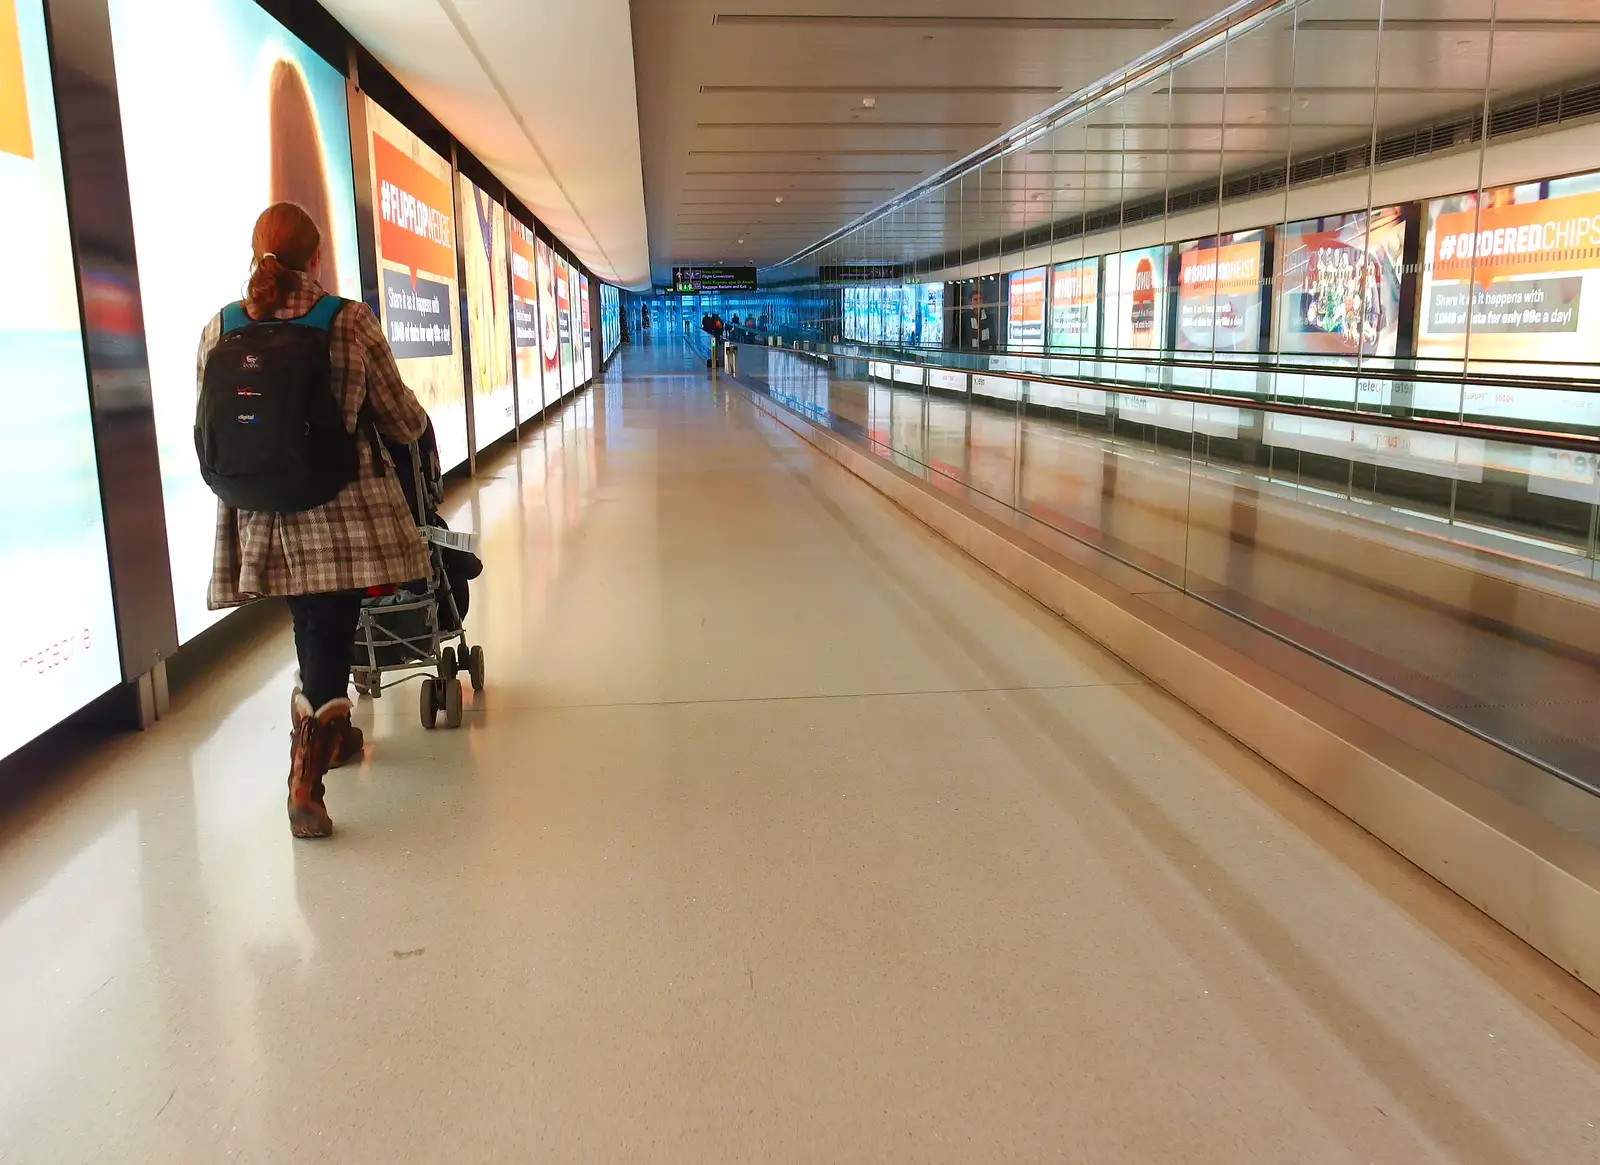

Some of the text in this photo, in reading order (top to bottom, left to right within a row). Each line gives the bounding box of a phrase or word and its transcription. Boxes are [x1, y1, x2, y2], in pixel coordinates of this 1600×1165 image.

[1435, 294, 1458, 307] Share
[1458, 292, 1466, 306] it
[1478, 292, 1484, 304] it
[1485, 291, 1522, 308] happens
[1524, 288, 1544, 303] with
[1487, 310, 1502, 324] for
[1502, 309, 1522, 327] only
[1542, 312, 1549, 322] a
